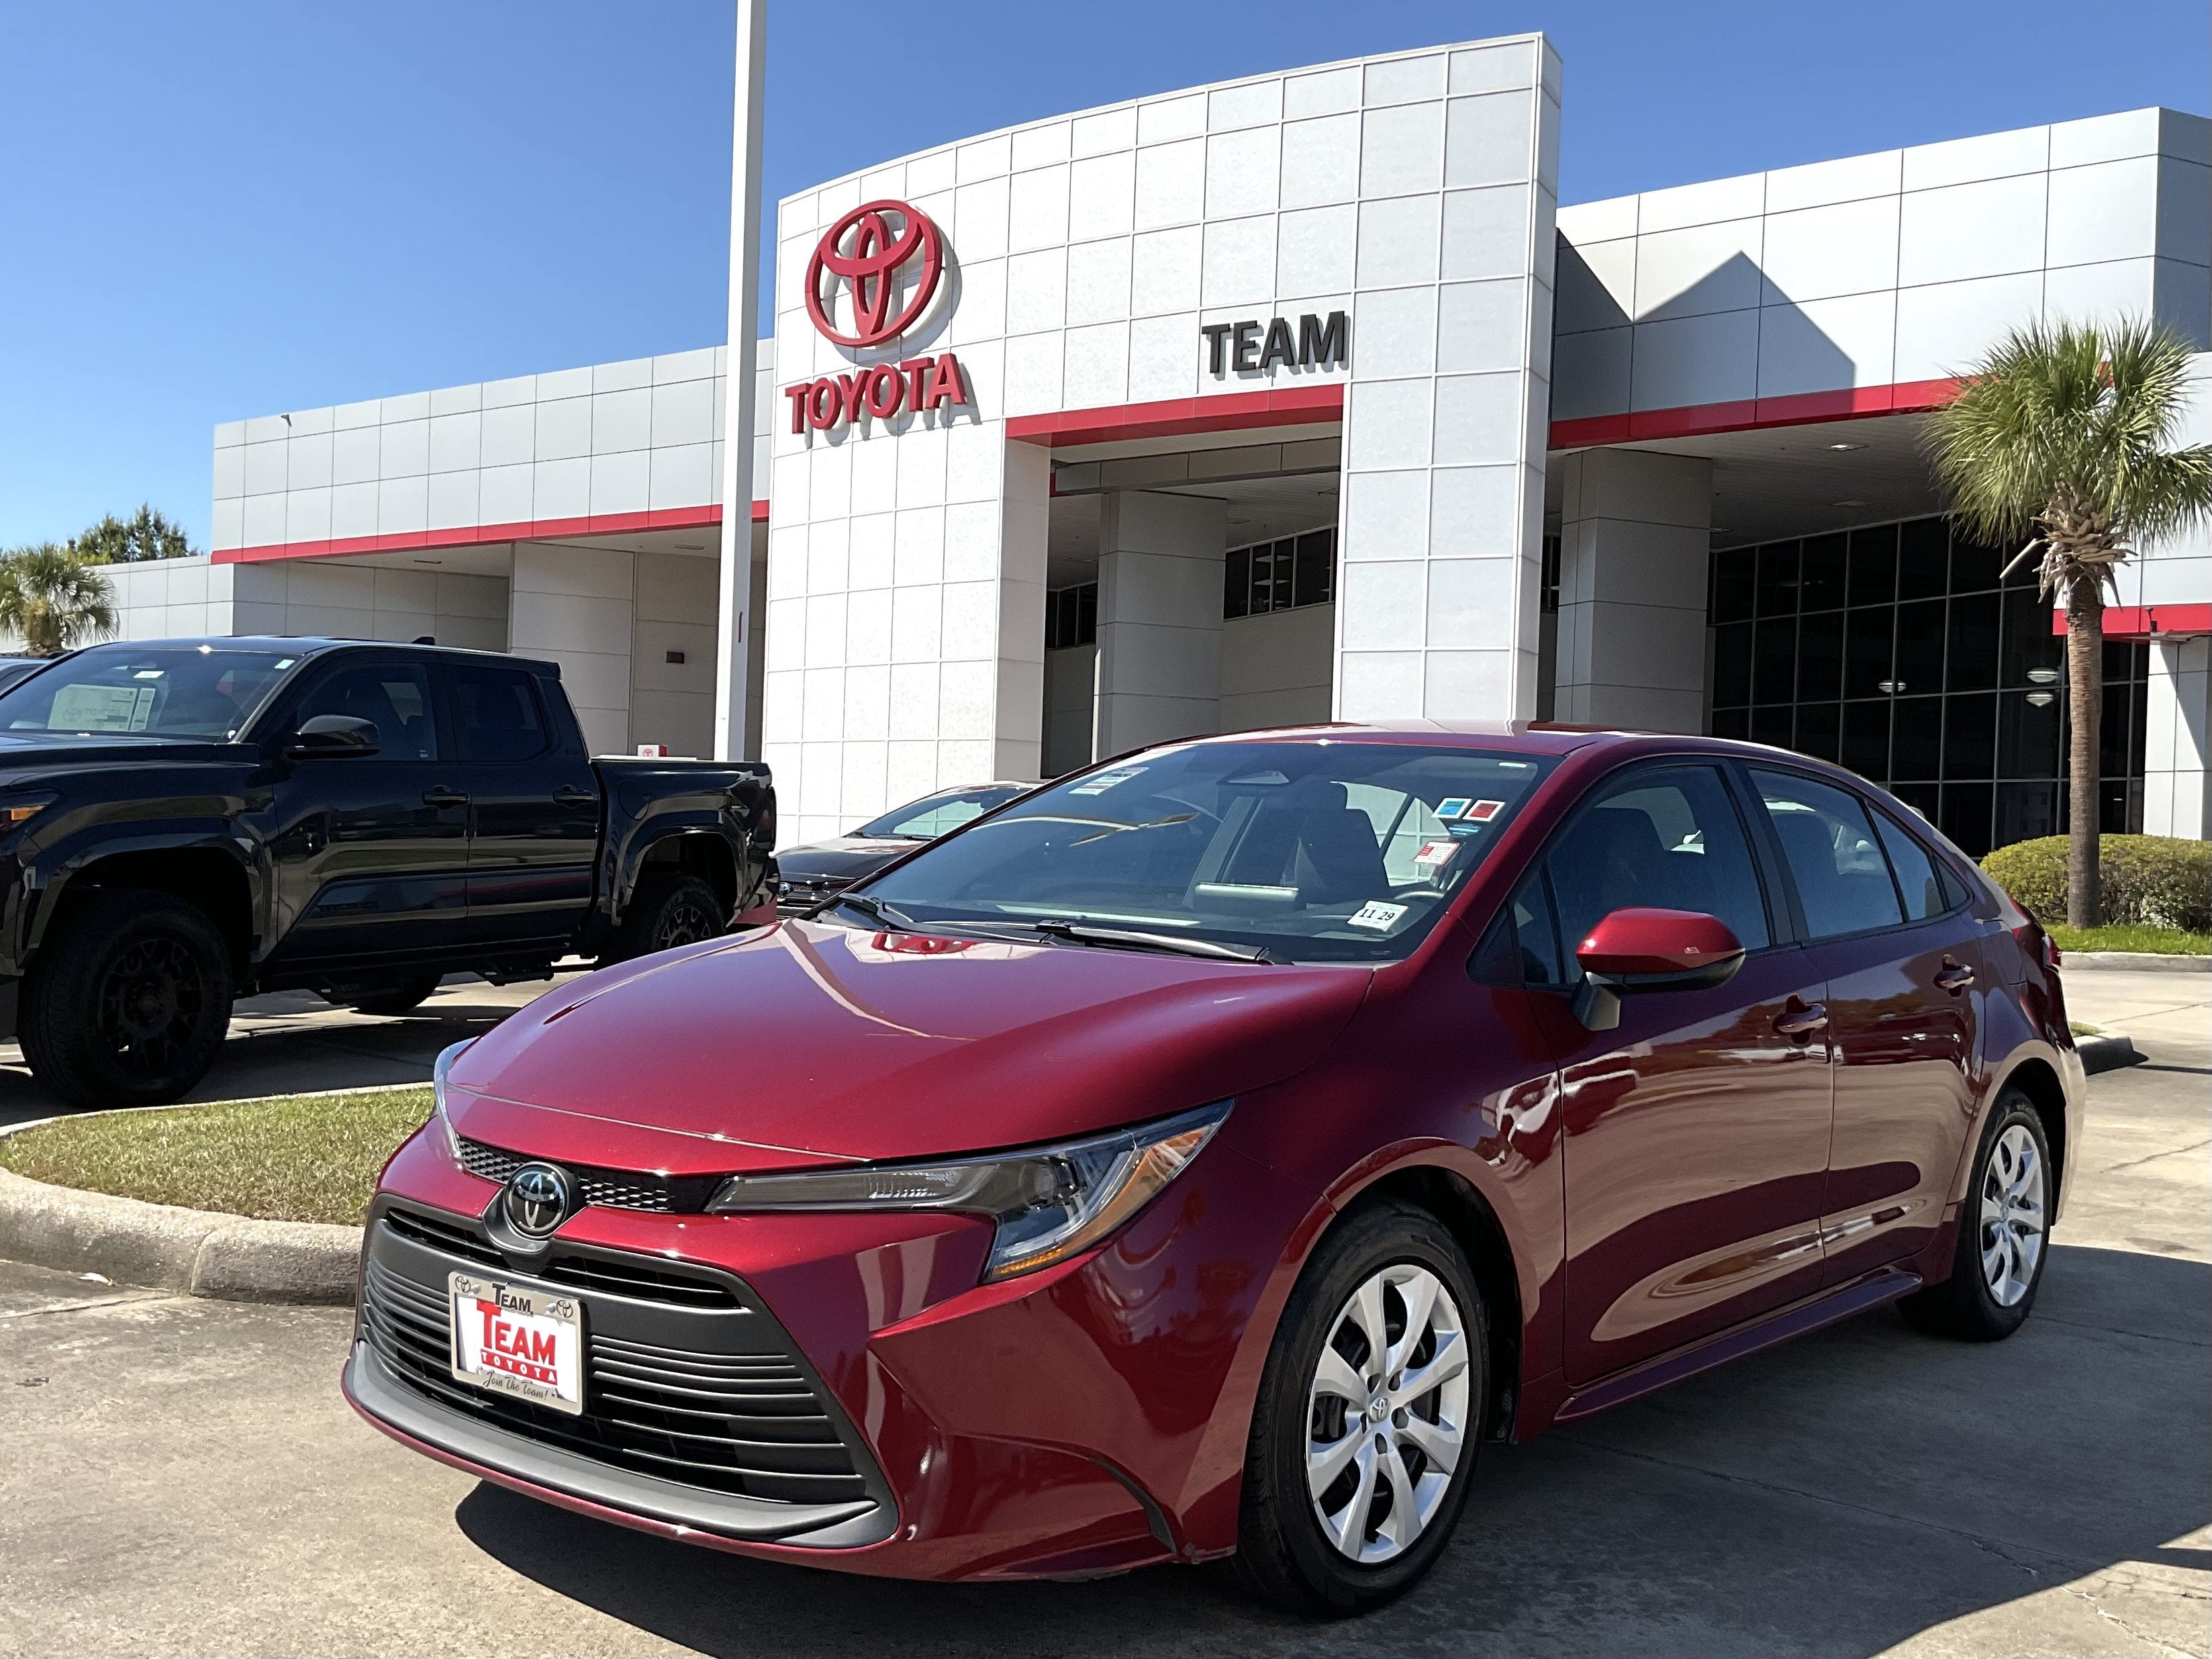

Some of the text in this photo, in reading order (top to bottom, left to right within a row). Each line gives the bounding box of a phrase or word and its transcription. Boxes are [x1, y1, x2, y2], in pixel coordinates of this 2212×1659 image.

[1202, 311, 1345, 373] TEAM
[785, 352, 967, 434] TOYOTA
[1359, 908, 1395, 921] 11 29
[477, 1298, 556, 1366] TEAM
[481, 1352, 555, 1382] TOYOTA
[483, 1370, 503, 1388] Join
